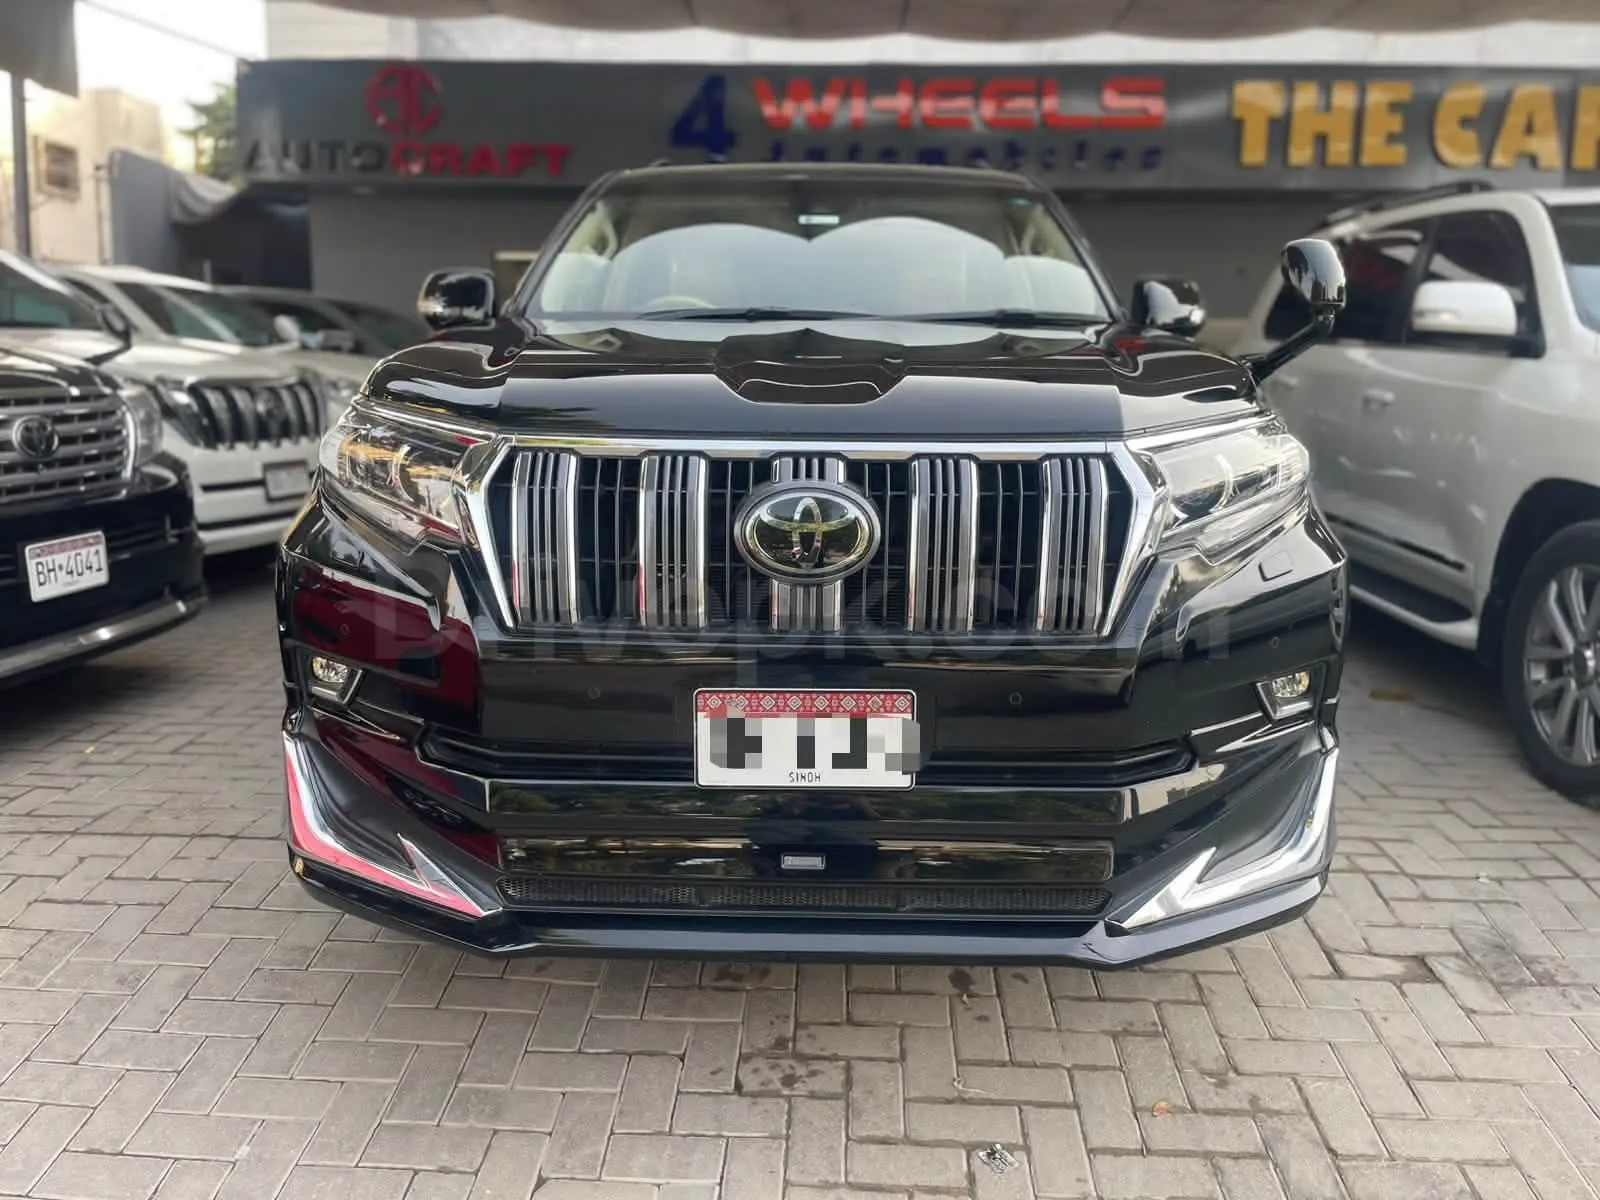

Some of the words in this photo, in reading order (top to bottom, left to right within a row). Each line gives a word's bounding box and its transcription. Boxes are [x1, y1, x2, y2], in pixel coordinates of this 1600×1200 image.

[244, 139, 574, 178] AUTOCRAFT
[670, 73, 739, 161] 4
[751, 76, 1167, 130] WHEELS
[1230, 79, 1413, 169] THE
